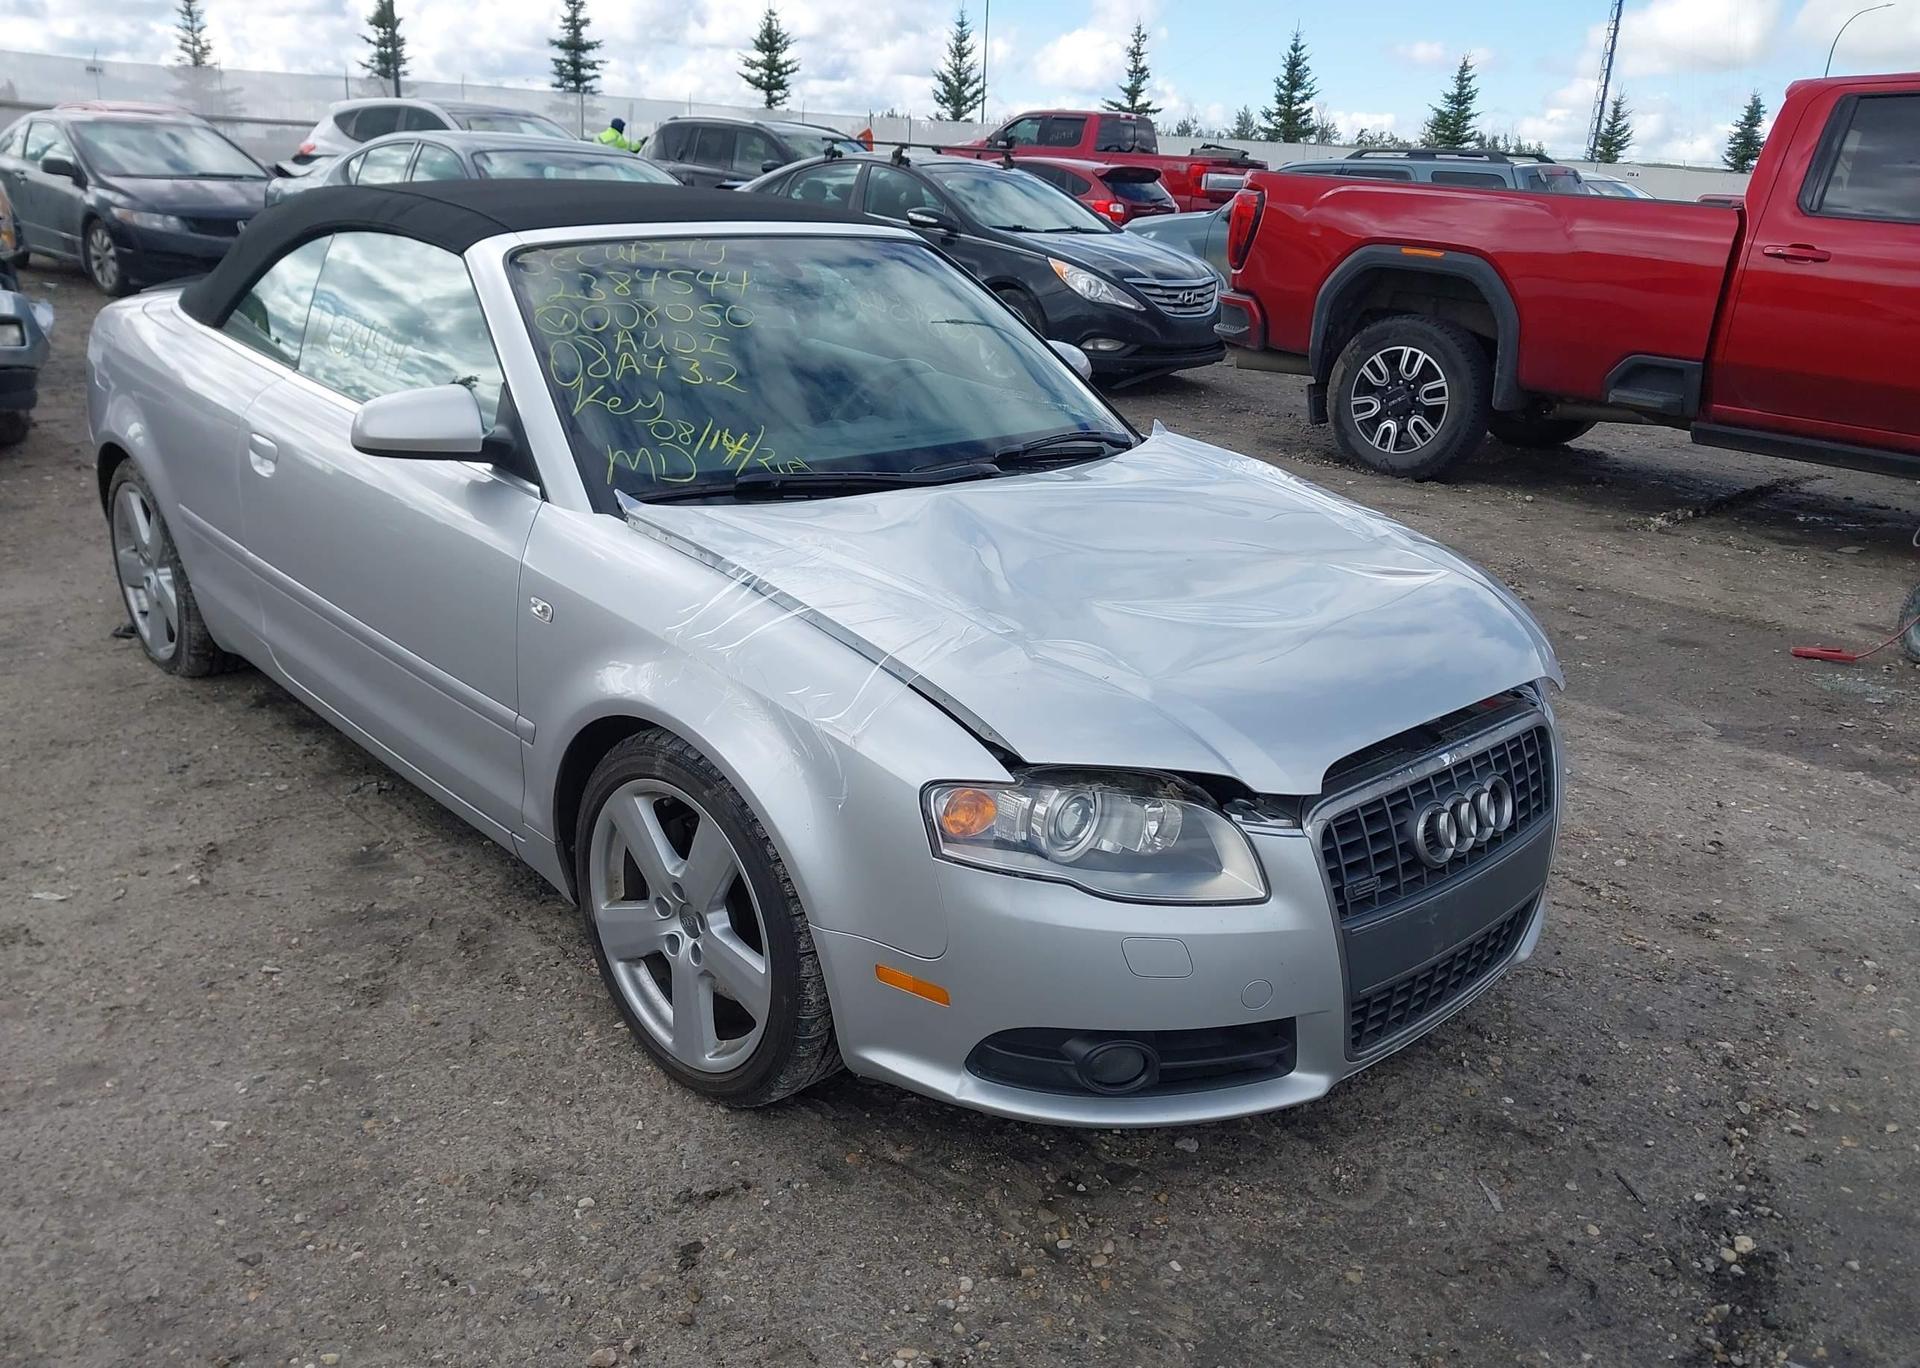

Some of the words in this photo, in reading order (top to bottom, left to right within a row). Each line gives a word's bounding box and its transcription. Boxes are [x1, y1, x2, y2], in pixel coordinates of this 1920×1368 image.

[547, 269, 751, 302] 2384544
[615, 330, 730, 356] AUDI
[615, 352, 667, 380] A4
[678, 357, 748, 392] 3.2
[572, 377, 665, 423] Key
[607, 442, 697, 484] MD
